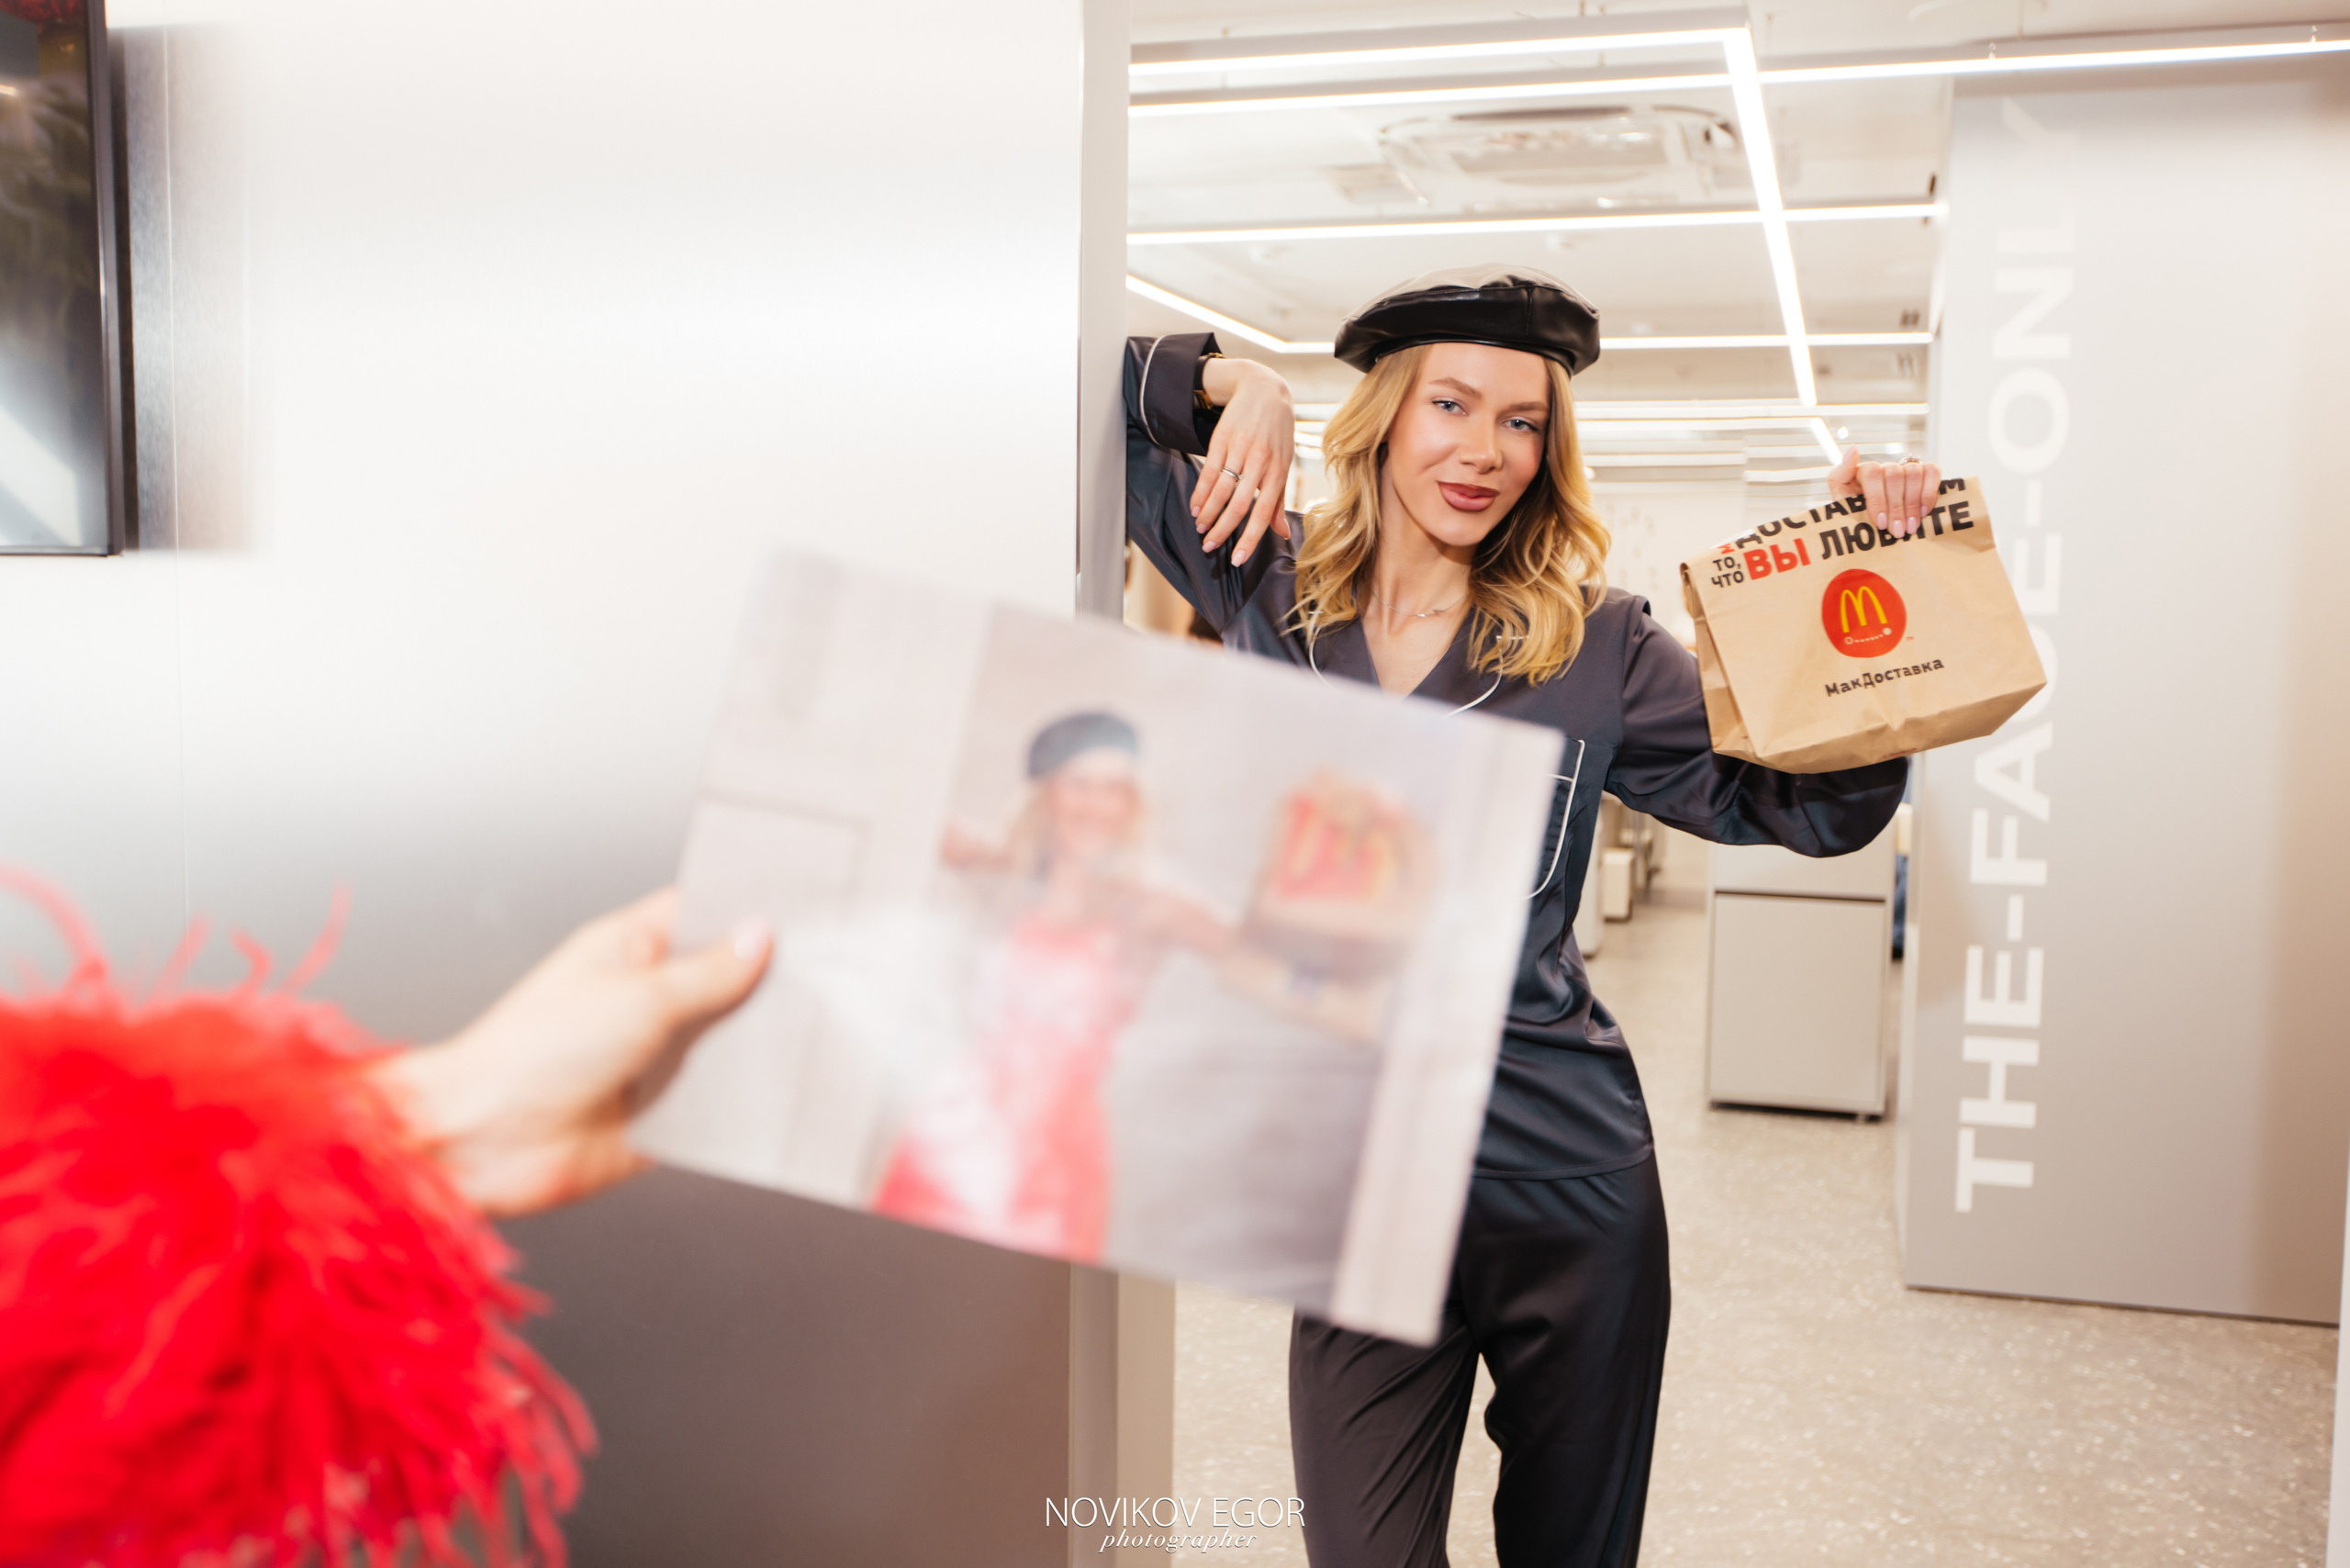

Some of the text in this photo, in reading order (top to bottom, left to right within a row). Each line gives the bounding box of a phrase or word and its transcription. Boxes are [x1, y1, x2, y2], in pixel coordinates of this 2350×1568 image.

[1744, 538, 1811, 580] ВЫ
[1711, 570, 1744, 588] ЧТО
[1825, 658, 1945, 697] МакДоставка
